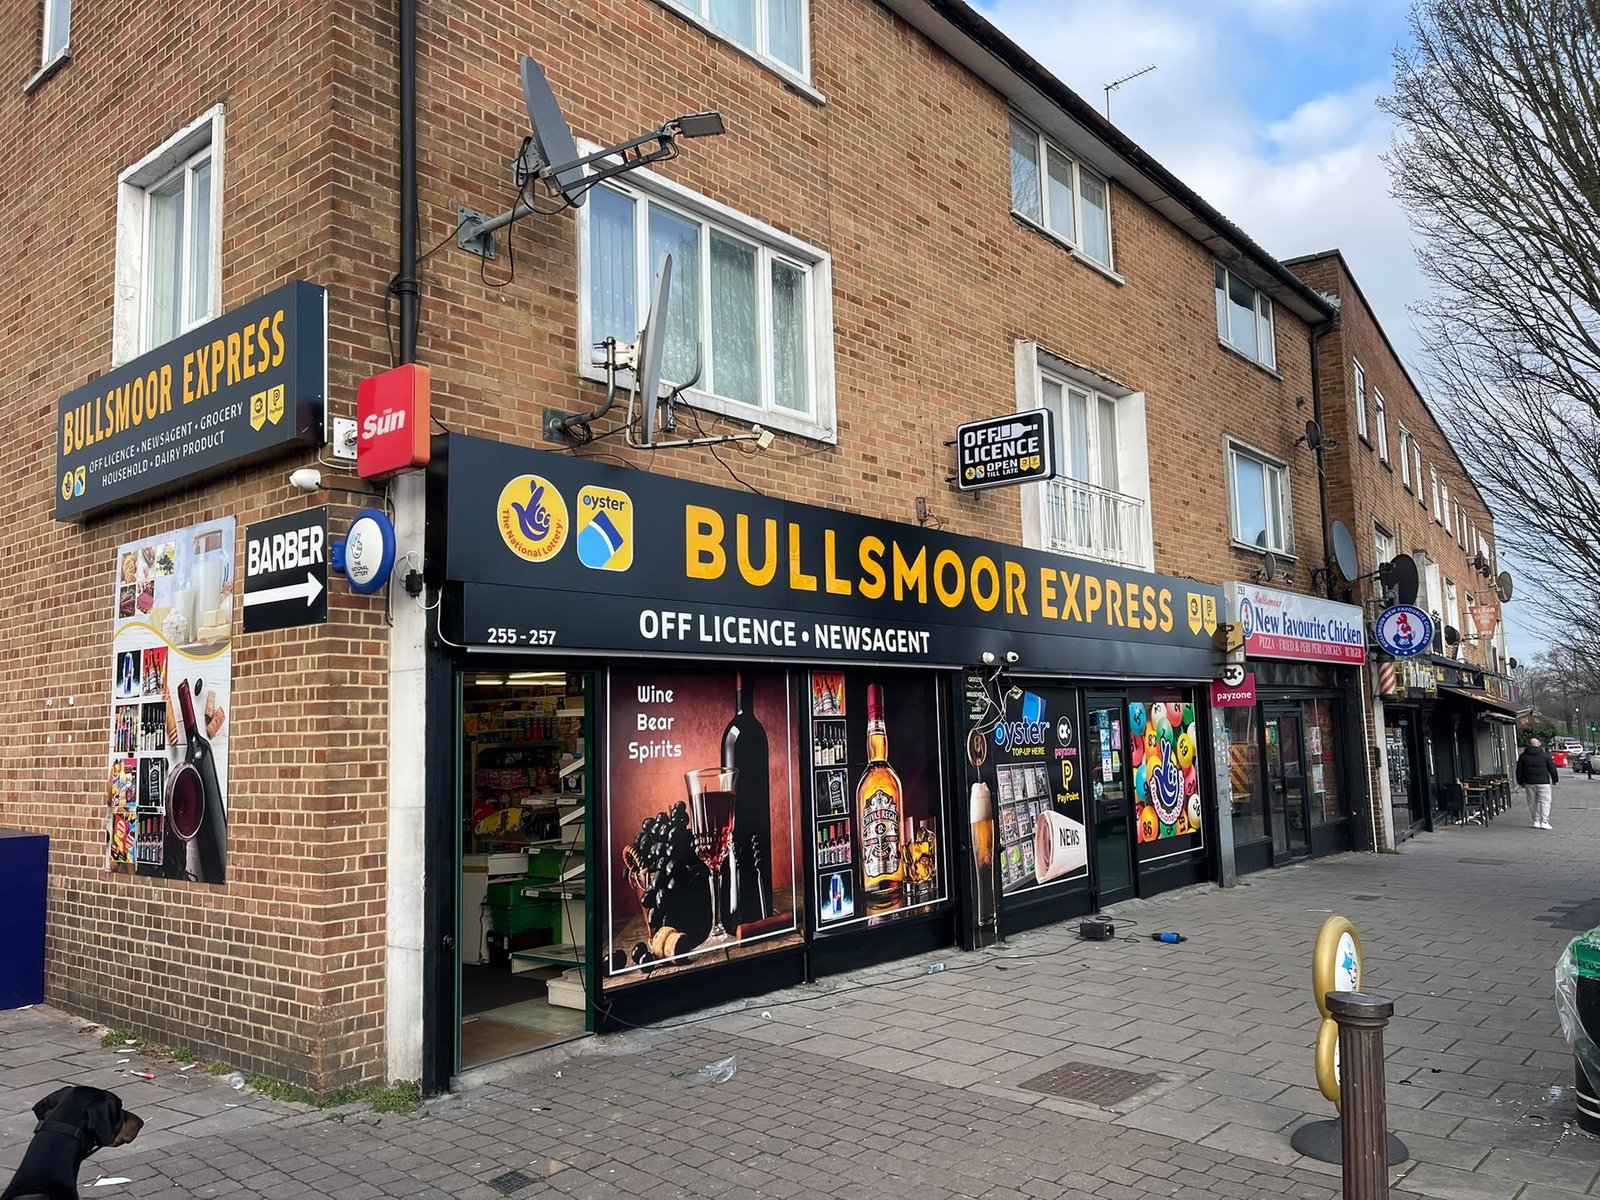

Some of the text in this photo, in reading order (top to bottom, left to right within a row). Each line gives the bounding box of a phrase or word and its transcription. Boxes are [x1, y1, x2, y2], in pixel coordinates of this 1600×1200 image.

[63, 309, 285, 456] BULLSMOOR EXPRESS
[383, 407, 393, 415] THE
[361, 409, 405, 440] Sun
[89, 401, 244, 474] OFF LICENCE NEWSAGENT GROCERY
[963, 426, 998, 448] OFF
[102, 430, 226, 487] HOUSEHOLD DAIRY PRODUCT
[964, 436, 1040, 465] LICENCE
[986, 458, 1018, 472] OPEN
[1002, 467, 1019, 475] LATE
[583, 494, 625, 511] oyster
[502, 509, 564, 557] The National Lottery
[247, 525, 324, 577] BARBER
[685, 504, 1175, 633] BULLSMOOR EXPRESS
[1237, 585, 1246, 595] 253
[1384, 608, 1397, 618] NEW
[638, 609, 931, 655] OFF LICENCE NEWSAGENT
[1255, 607, 1362, 645] New Favourite Chicken
[487, 627, 517, 644] 255
[529, 629, 557, 646] 257
[1259, 636, 1275, 649] PIZZA
[637, 685, 674, 704] Wine
[1217, 691, 1252, 702] payzone
[636, 713, 675, 732] Bear
[994, 716, 1047, 753] oyster
[628, 740, 682, 764] Spirits
[1012, 747, 1046, 756] TOP-UP HERE
[1055, 747, 1077, 759] payzone
[1057, 791, 1079, 804] PayPoint
[1059, 827, 1080, 846] NEWS
